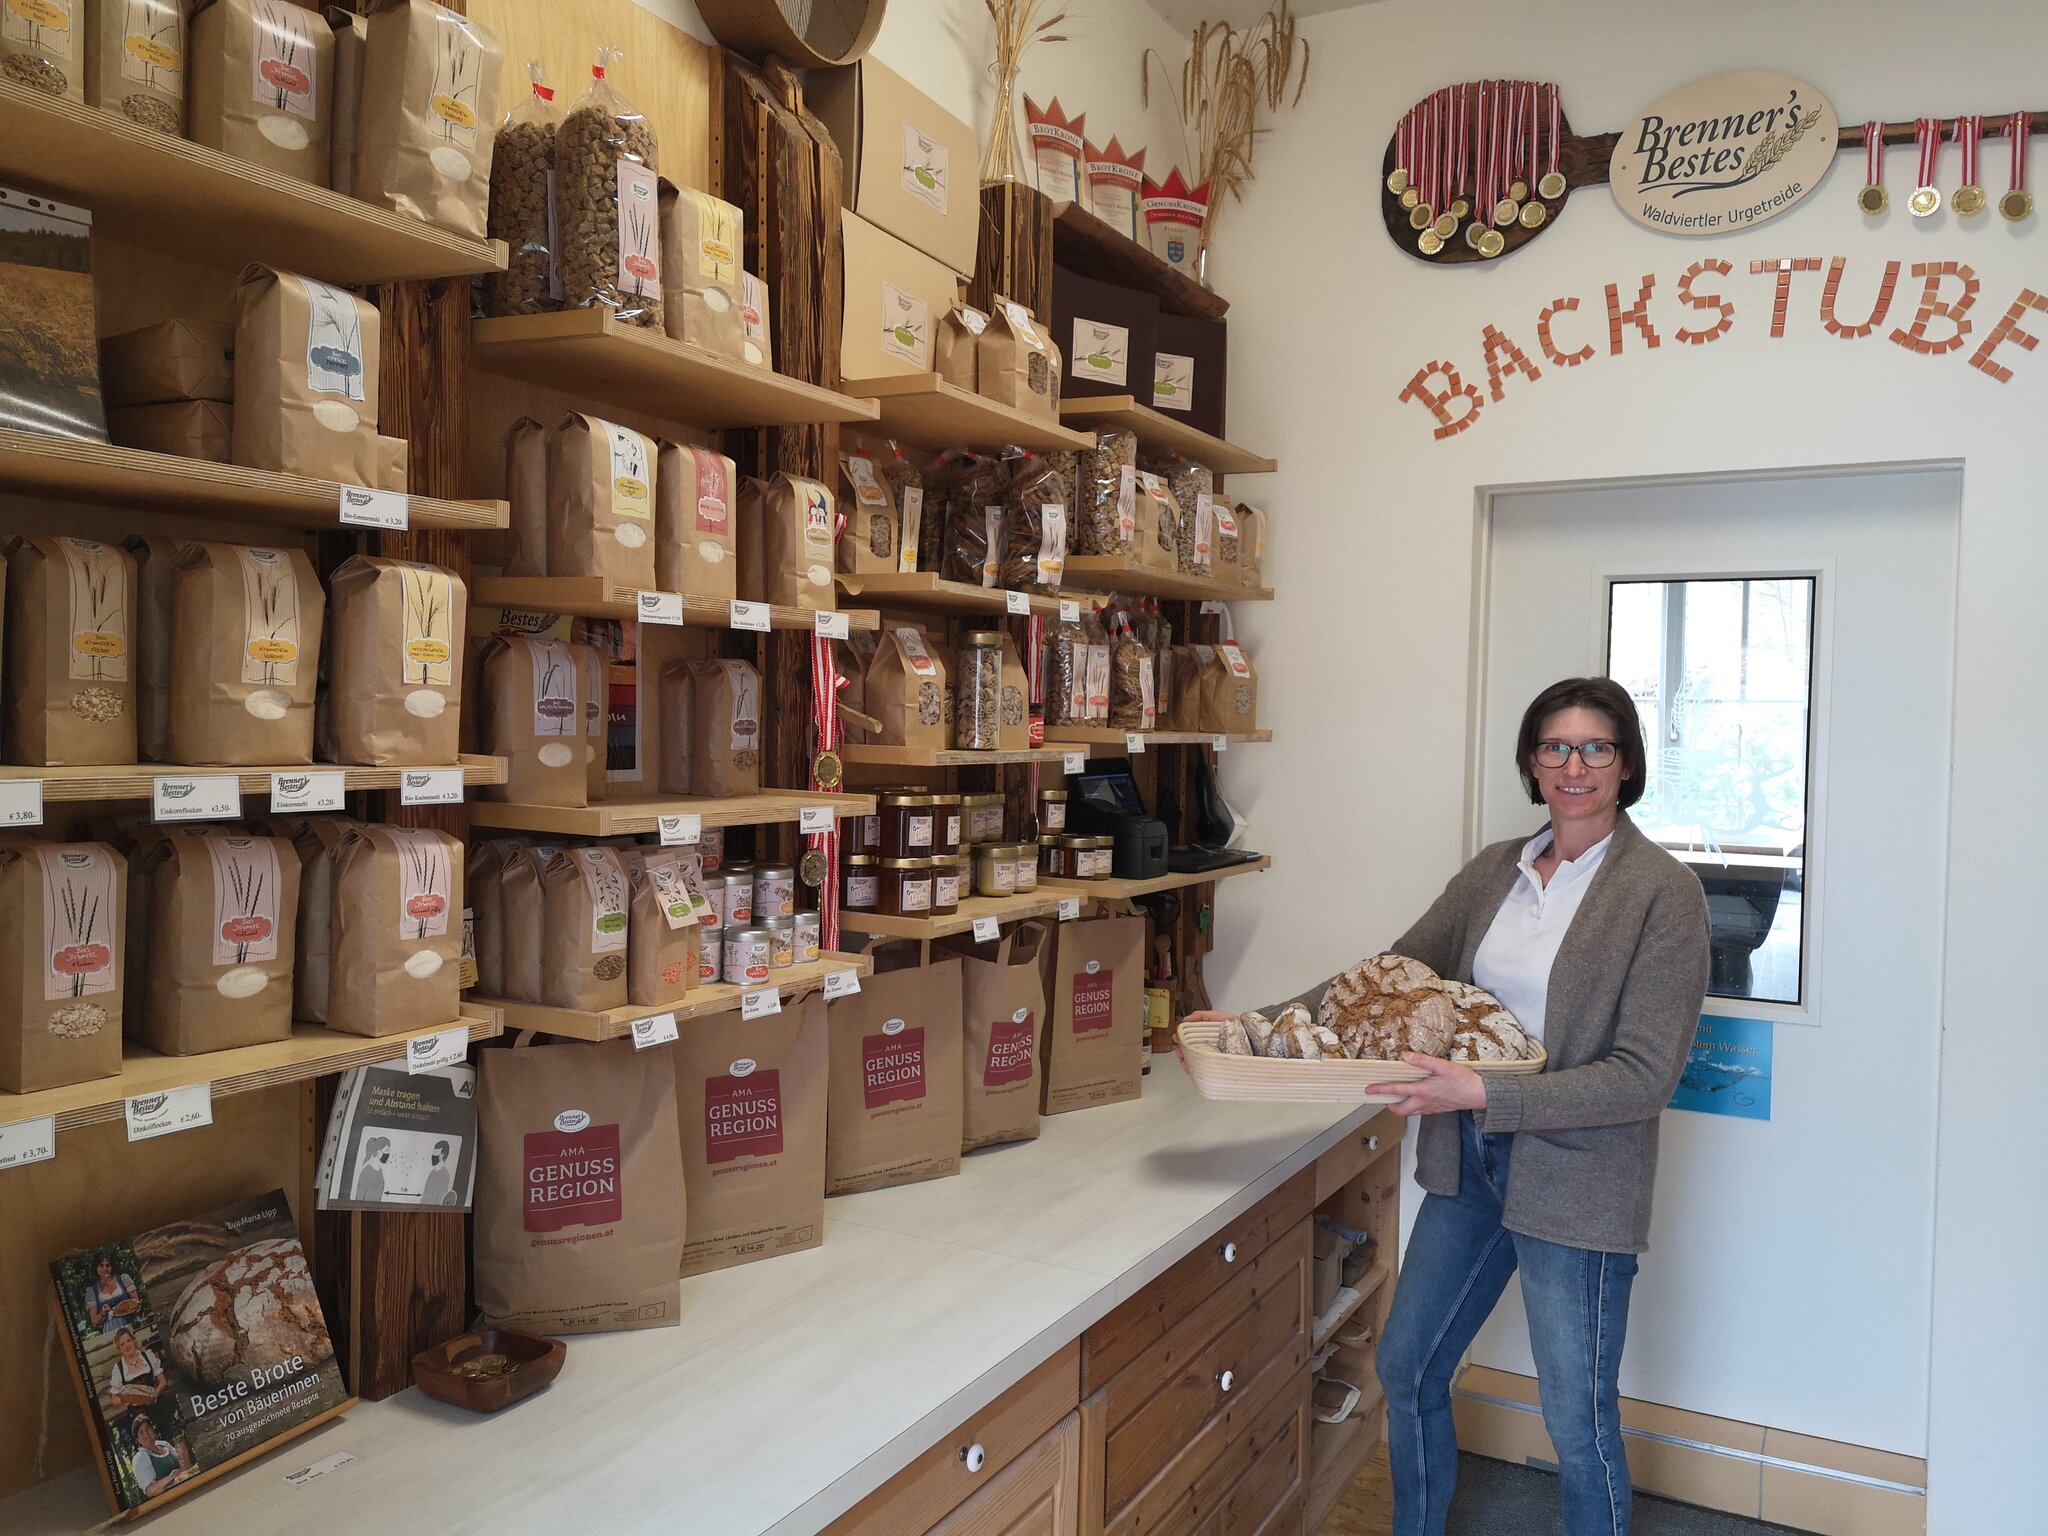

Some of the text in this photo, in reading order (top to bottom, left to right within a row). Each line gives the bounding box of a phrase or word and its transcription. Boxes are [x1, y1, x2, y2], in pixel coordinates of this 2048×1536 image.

[1633, 90, 1802, 155] Brenner's
[1638, 146, 1746, 185] Bestes
[1642, 181, 1803, 227] Waldviertler Urgetreide
[1399, 257, 2048, 441] BACKSTUBE
[500, 608, 540, 628] Bestes
[161, 781, 193, 793] Brenner's
[277, 774, 309, 787] Brenner's
[15, 811, 36, 821] 3,80-
[160, 806, 203, 815] Einkornflocken
[1074, 989, 1110, 1003] GENUSS
[1075, 1001, 1109, 1016] REGION
[885, 1043, 902, 1052] AMA
[1719, 1041, 1757, 1055] Wasser
[866, 1051, 920, 1071] GENUSS
[867, 1065, 921, 1086] REGION
[131, 1092, 167, 1109] Brenner's
[371, 1086, 420, 1102] Maske tragen
[732, 1088, 753, 1098] AMA
[133, 1103, 155, 1115] Bestes
[369, 1096, 440, 1113] und Abstand halten
[709, 1098, 777, 1120] GENUSS
[133, 1120, 173, 1134] Dinkelflocken
[710, 1115, 777, 1137] REGION
[22, 1151, 28, 1159] €
[28, 1146, 49, 1159] 3,70-
[560, 1146, 585, 1158] AMA
[529, 1158, 615, 1183] GENUSS
[712, 1160, 778, 1177] genussregionen.at
[530, 1177, 614, 1203] REGION
[227, 1208, 278, 1230] Eva Maria Lipp
[530, 1229, 615, 1248] genussregionen.at
[190, 1355, 304, 1418] Beste Brote
[219, 1373, 321, 1428] von Bäuerinnen
[225, 1392, 320, 1443] 70 ausgezeichnete Rezepte
